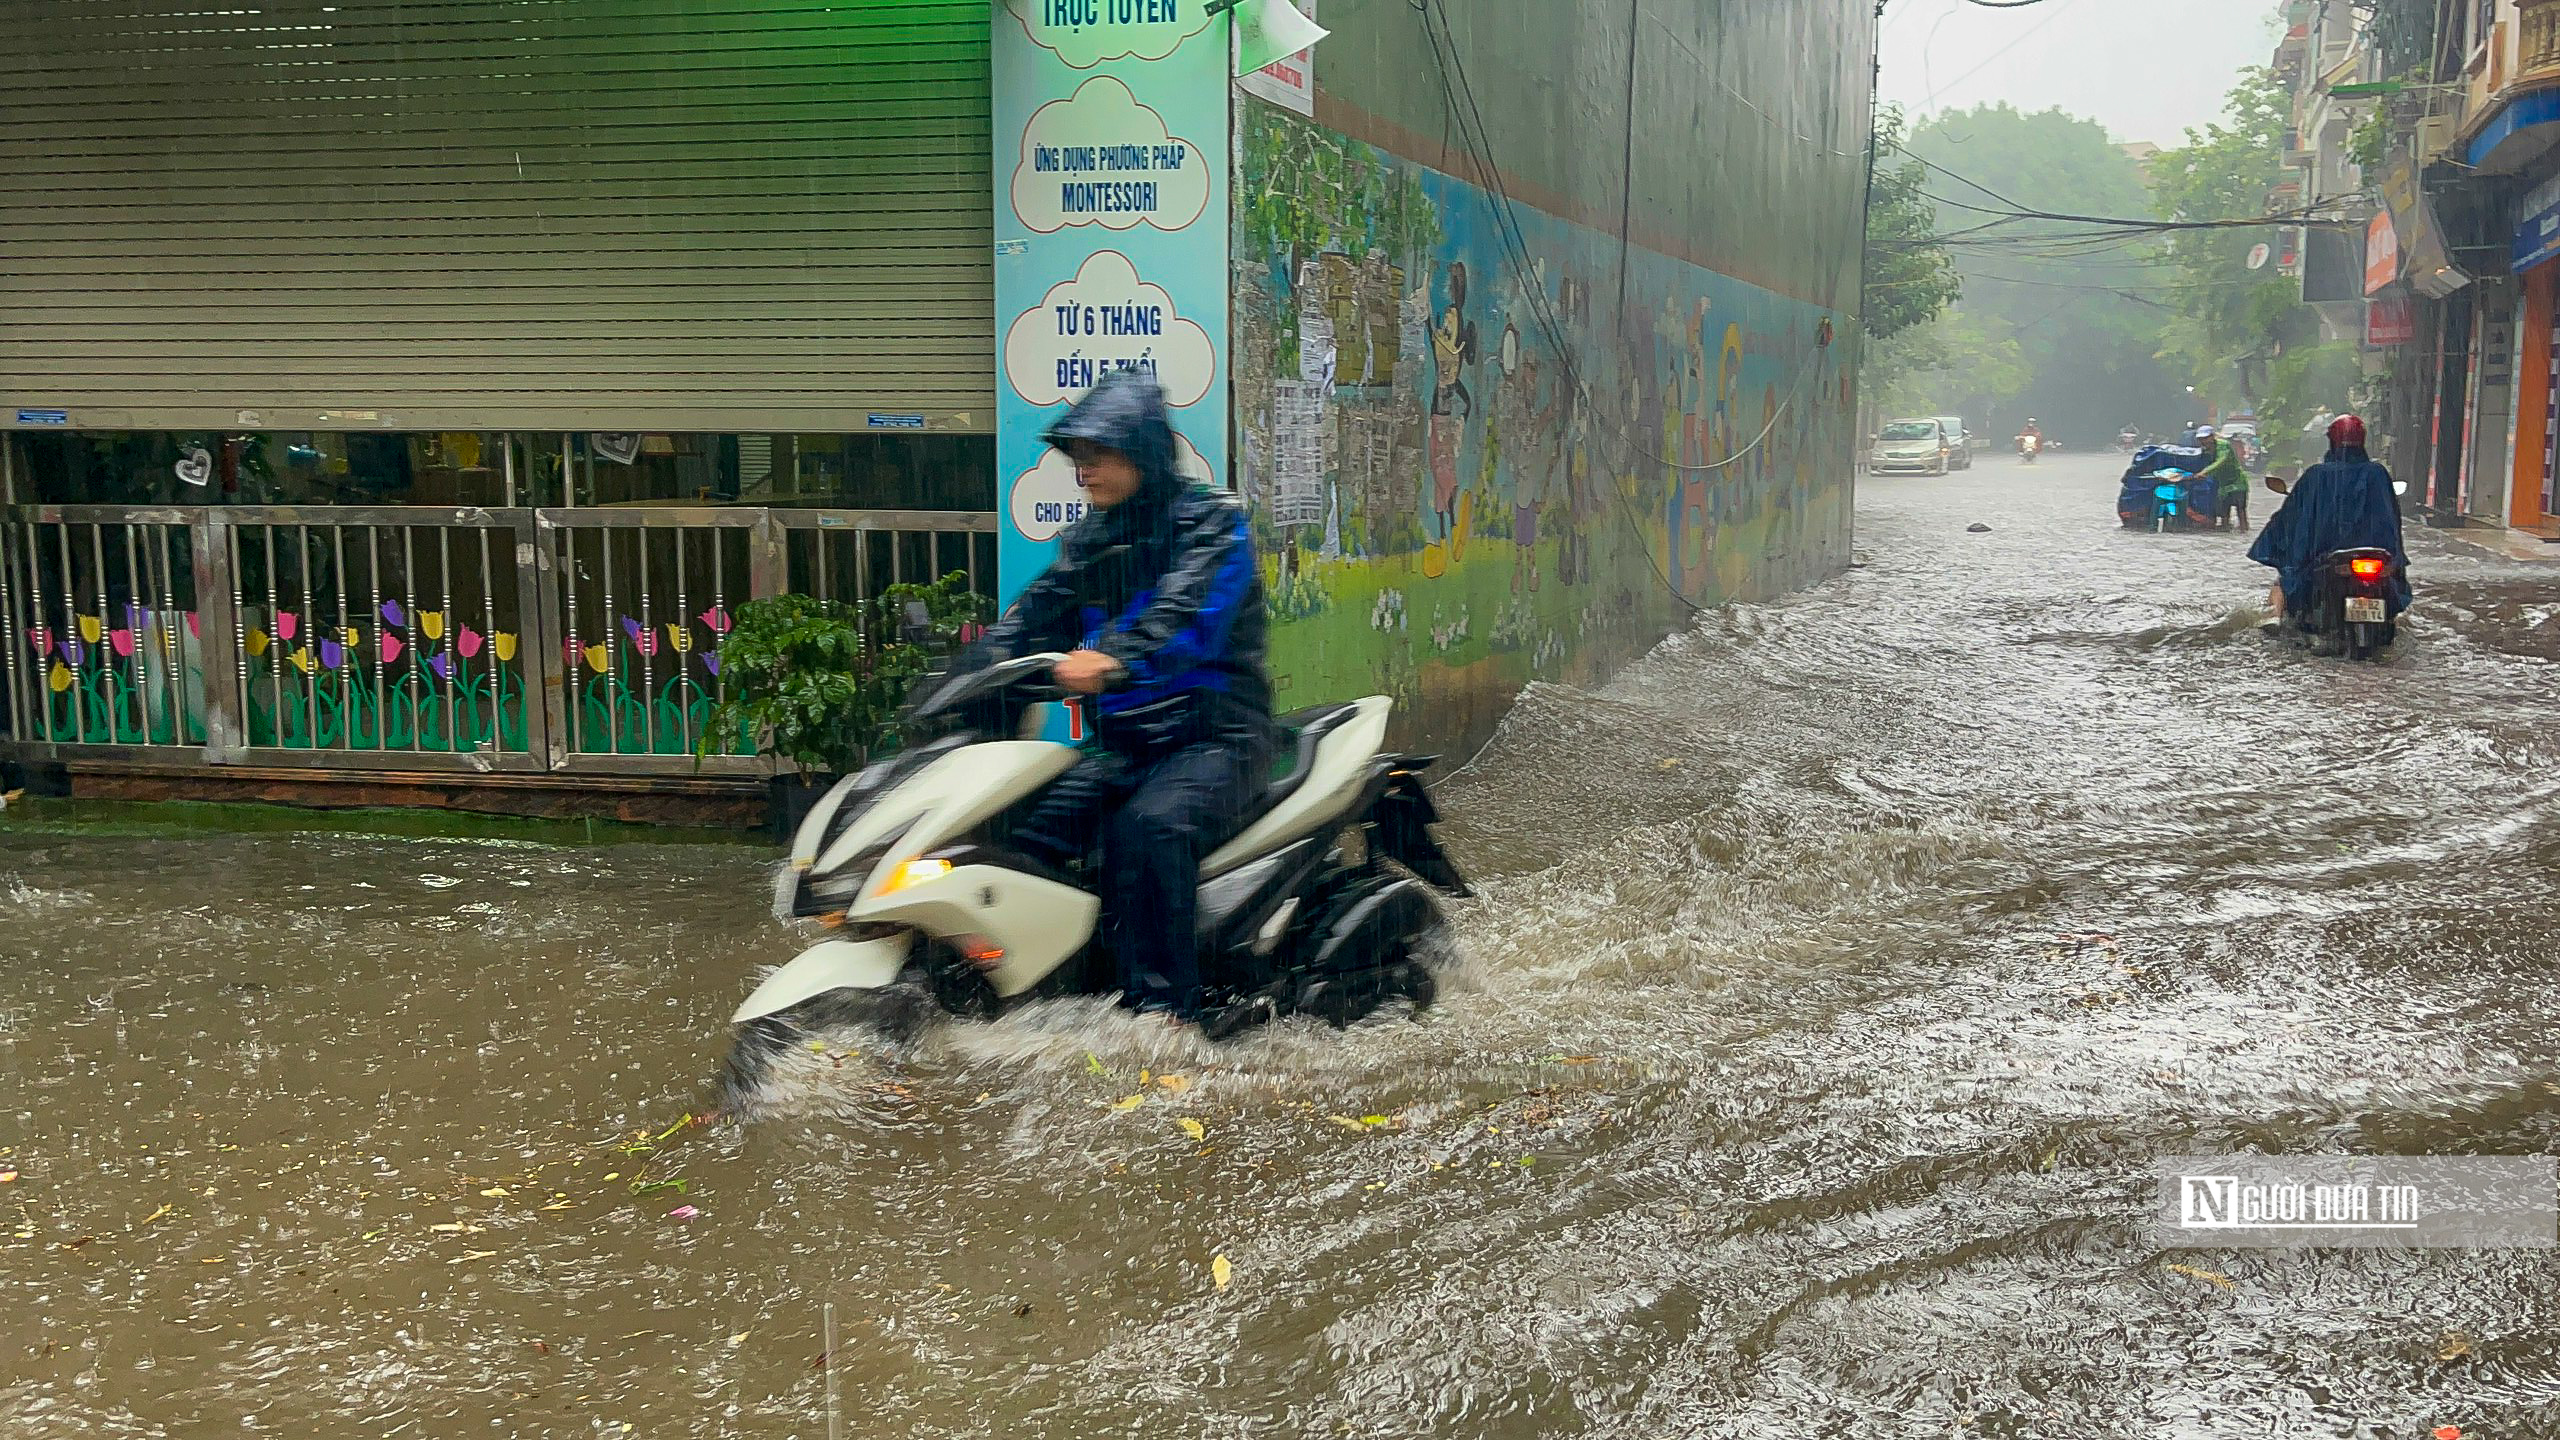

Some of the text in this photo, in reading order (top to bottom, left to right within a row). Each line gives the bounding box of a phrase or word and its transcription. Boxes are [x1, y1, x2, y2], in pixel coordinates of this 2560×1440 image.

[1034, 140, 1185, 177] ỨNG DỤNG PHƯƠNG PHÁP
[1062, 181, 1158, 212] MONTESSORI
[1056, 299, 1161, 335] TỪ 6 THÁNG
[1056, 349, 1093, 388] ĐẾN
[1035, 502, 1062, 523] CHO
[1066, 499, 1083, 523] BÉ
